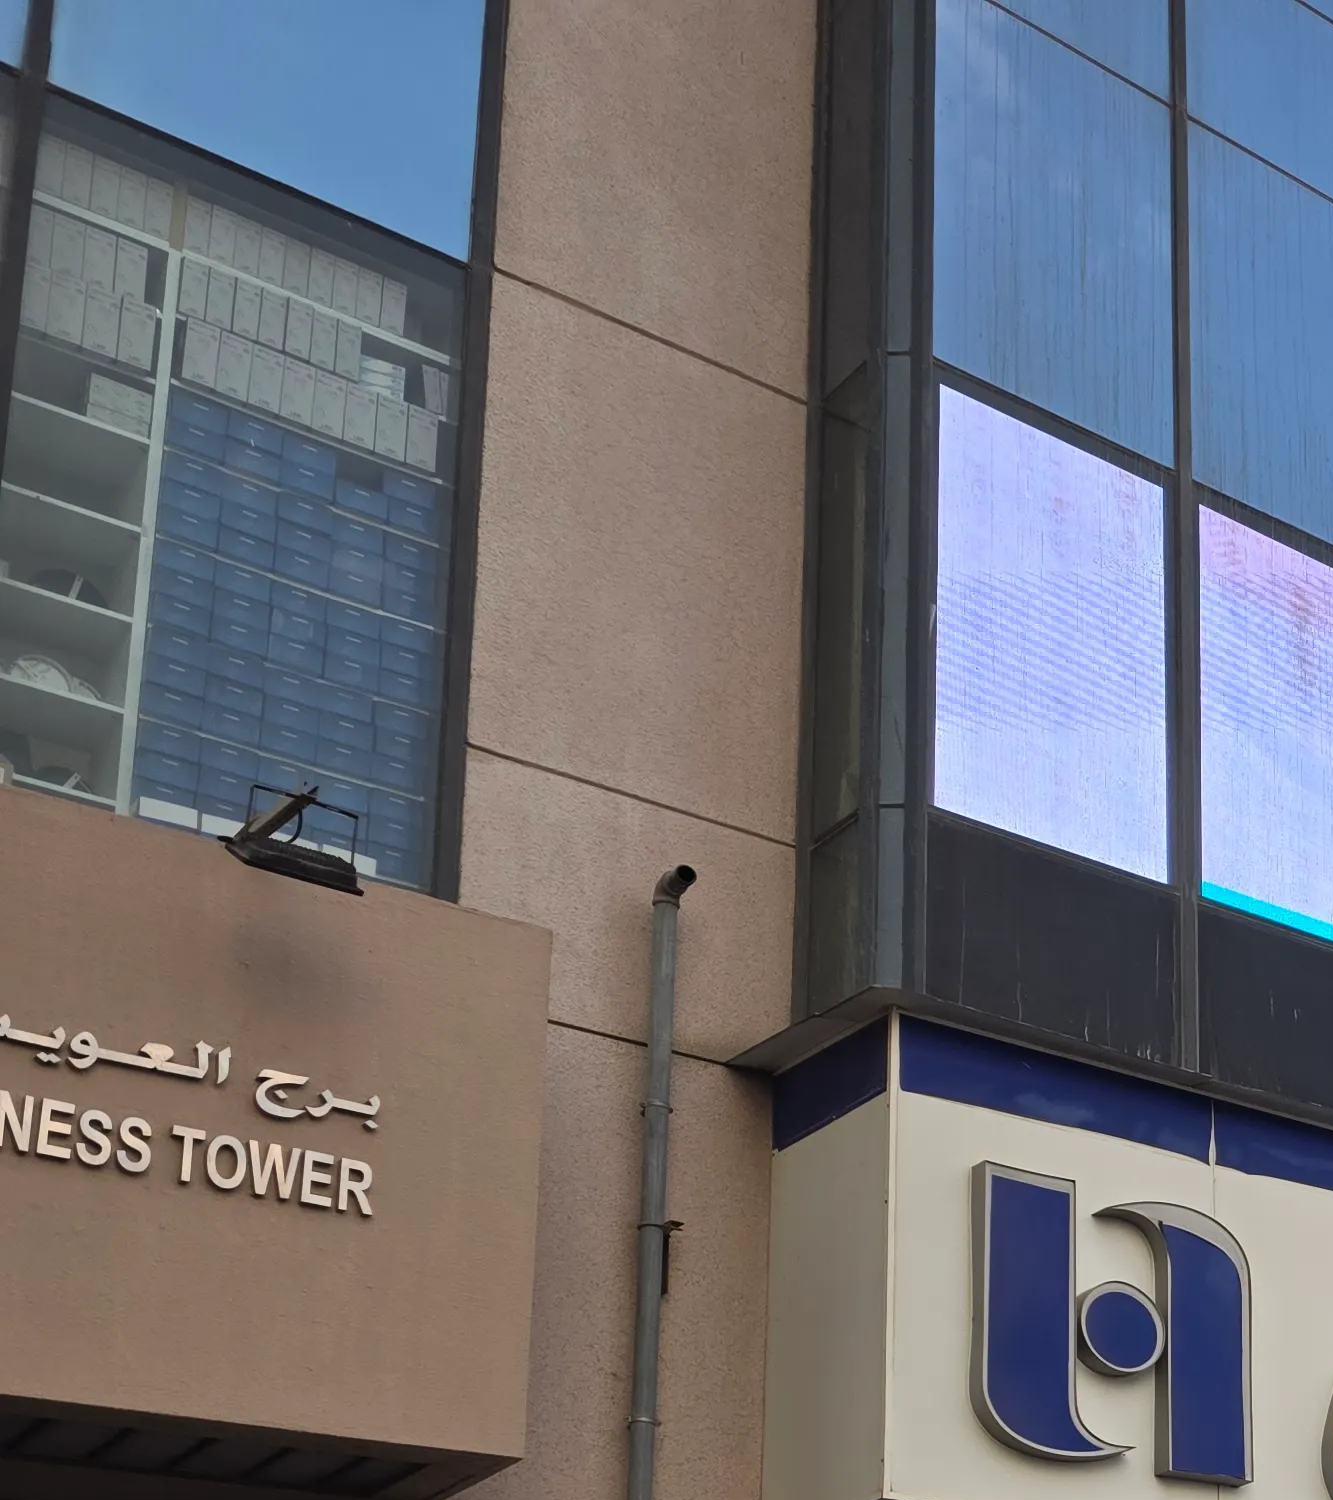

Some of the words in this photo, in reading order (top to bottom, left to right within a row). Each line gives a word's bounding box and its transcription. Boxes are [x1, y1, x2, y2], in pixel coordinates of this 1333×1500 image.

[255, 1068, 381, 1131] برج
[0, 1088, 153, 1174] NESS
[170, 1123, 375, 1217] TOWER
